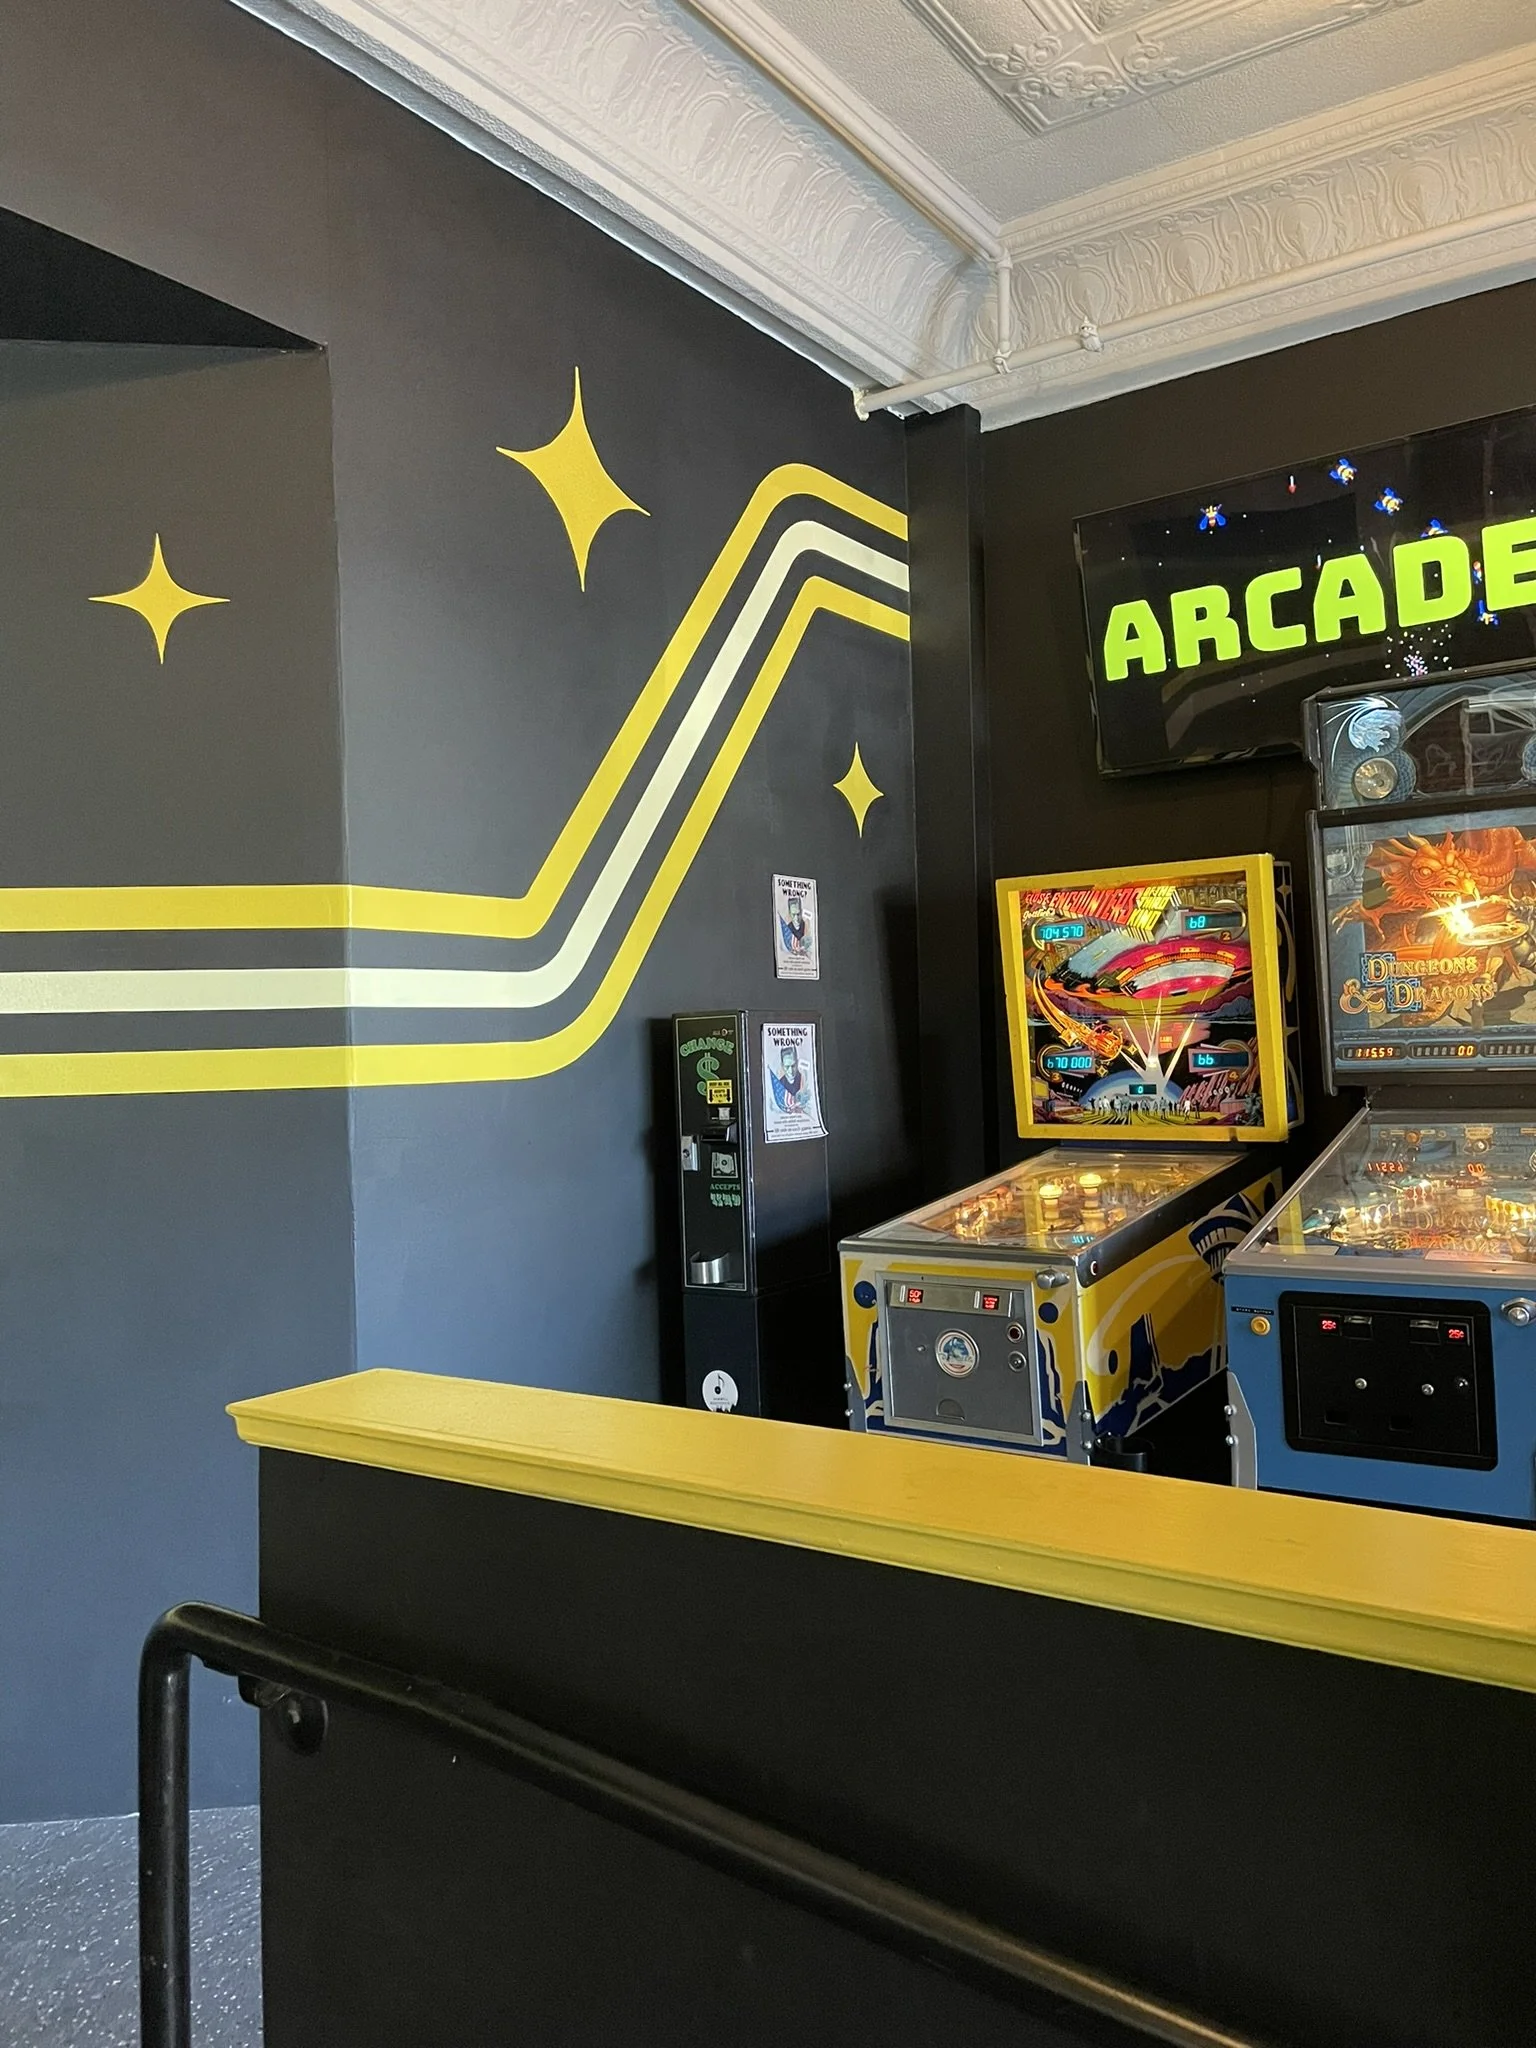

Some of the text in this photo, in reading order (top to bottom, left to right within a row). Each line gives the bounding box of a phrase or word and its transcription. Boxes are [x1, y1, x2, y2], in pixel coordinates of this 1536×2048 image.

[1104, 516, 1536, 682] ARCADE
[778, 878, 812, 890] SOMETHING
[783, 888, 808, 899] WRONG?
[1025, 886, 1146, 926] CLOSE ENCOUNTERS
[1127, 909, 1162, 930] KIND
[1339, 978, 1386, 1015] &
[767, 1027, 808, 1037] SOMETHING
[679, 1036, 735, 1057] CHANGE
[773, 1037, 804, 1047] WRONG?
[1321, 1319, 1337, 1330] 25¢
[1448, 1328, 1465, 1339] 25¢
